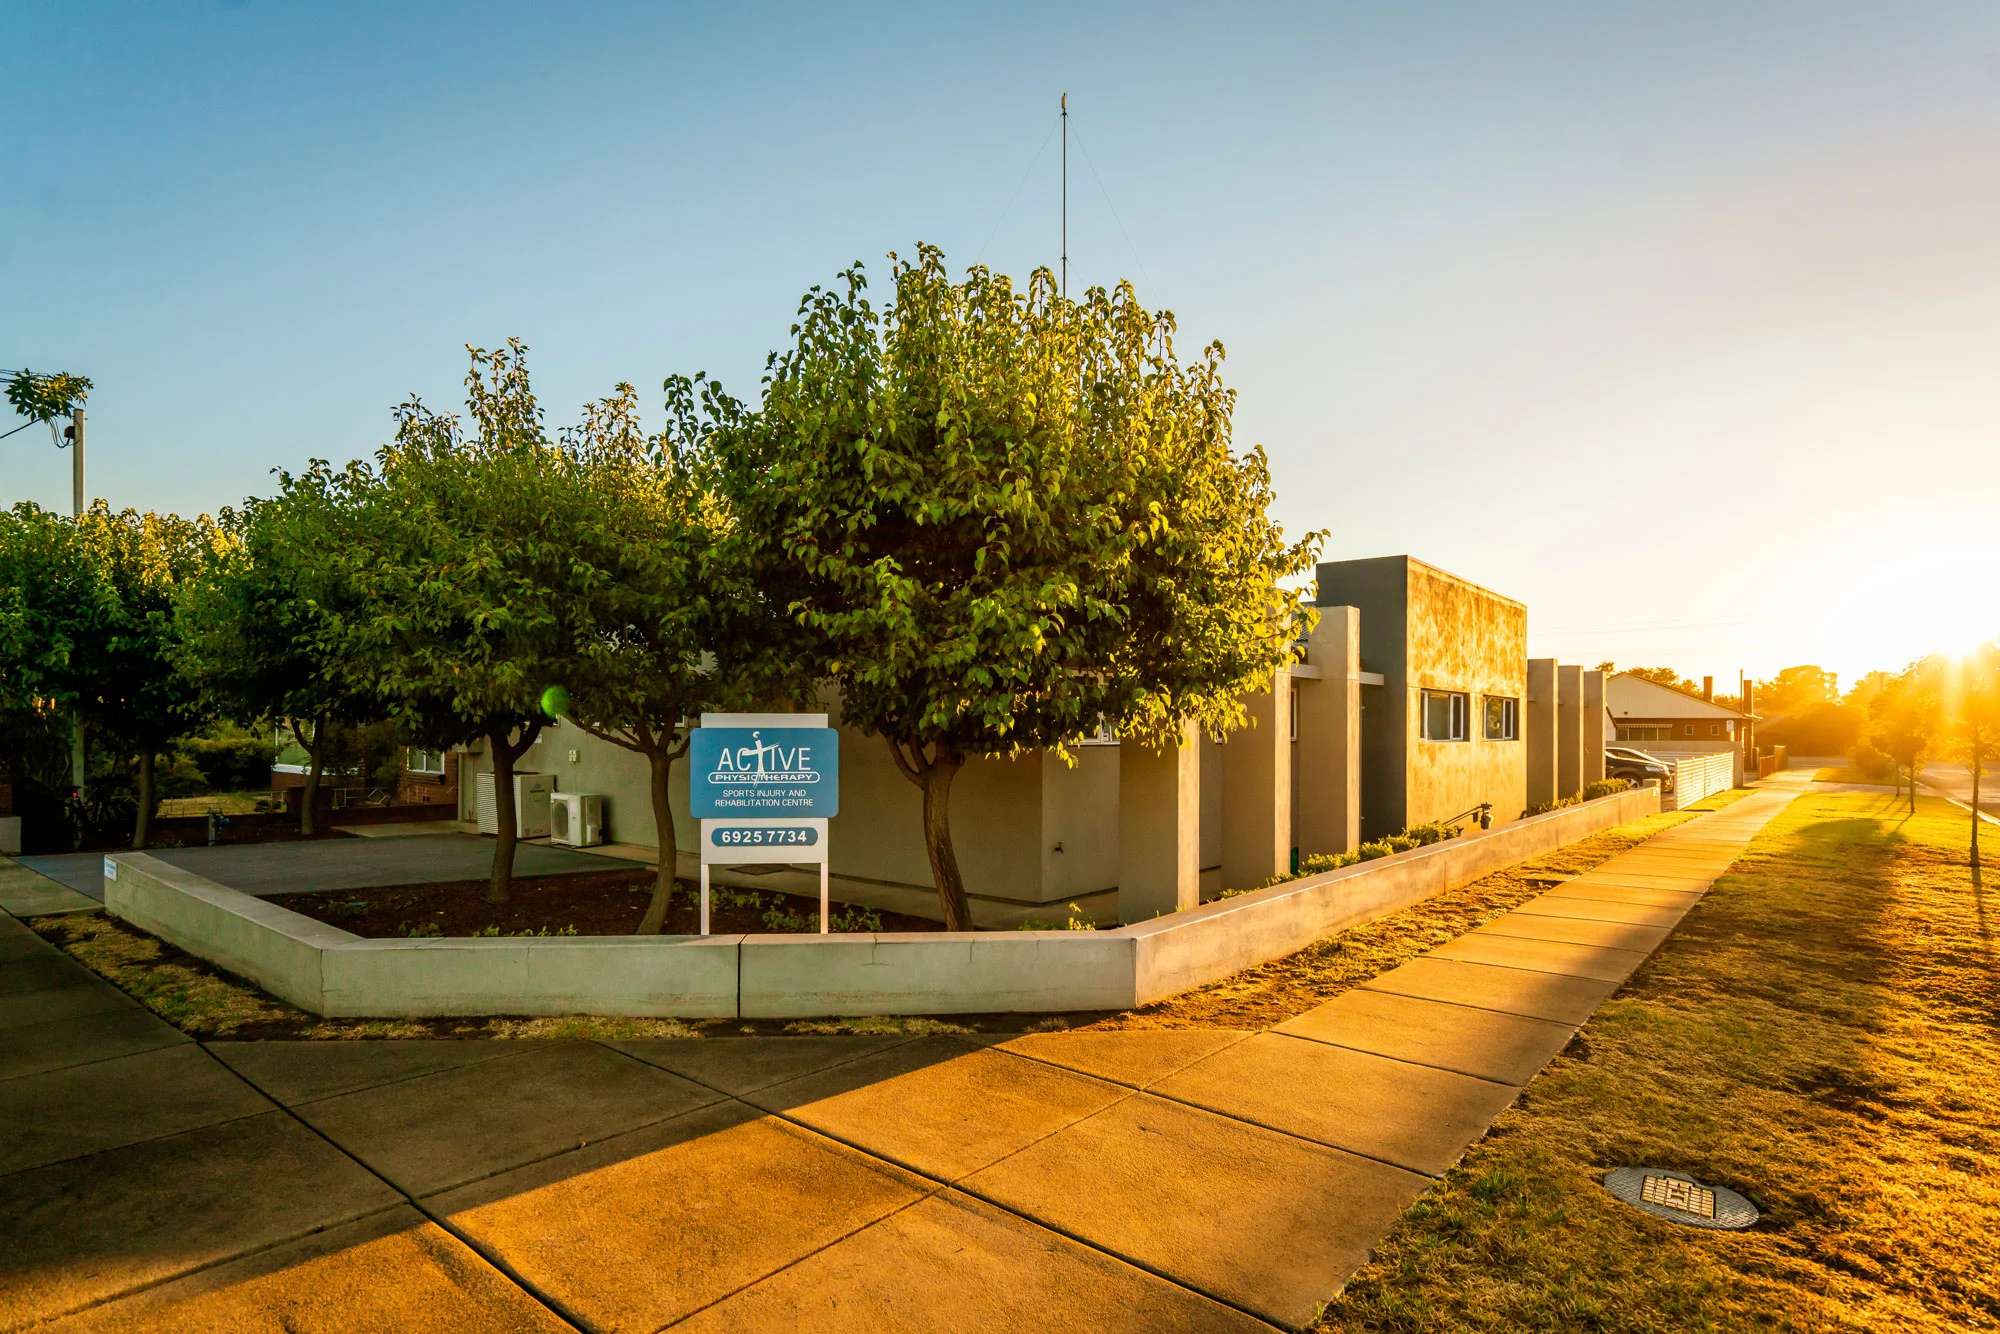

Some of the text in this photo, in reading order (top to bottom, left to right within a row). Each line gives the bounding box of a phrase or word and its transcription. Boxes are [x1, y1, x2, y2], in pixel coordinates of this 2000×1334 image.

[717, 739, 811, 771] ACTIVE
[723, 789, 806, 797] SPORTS INJURY AND
[715, 798, 814, 807] REHABILITATION CENTRE
[722, 830, 807, 843] 6925 7734
